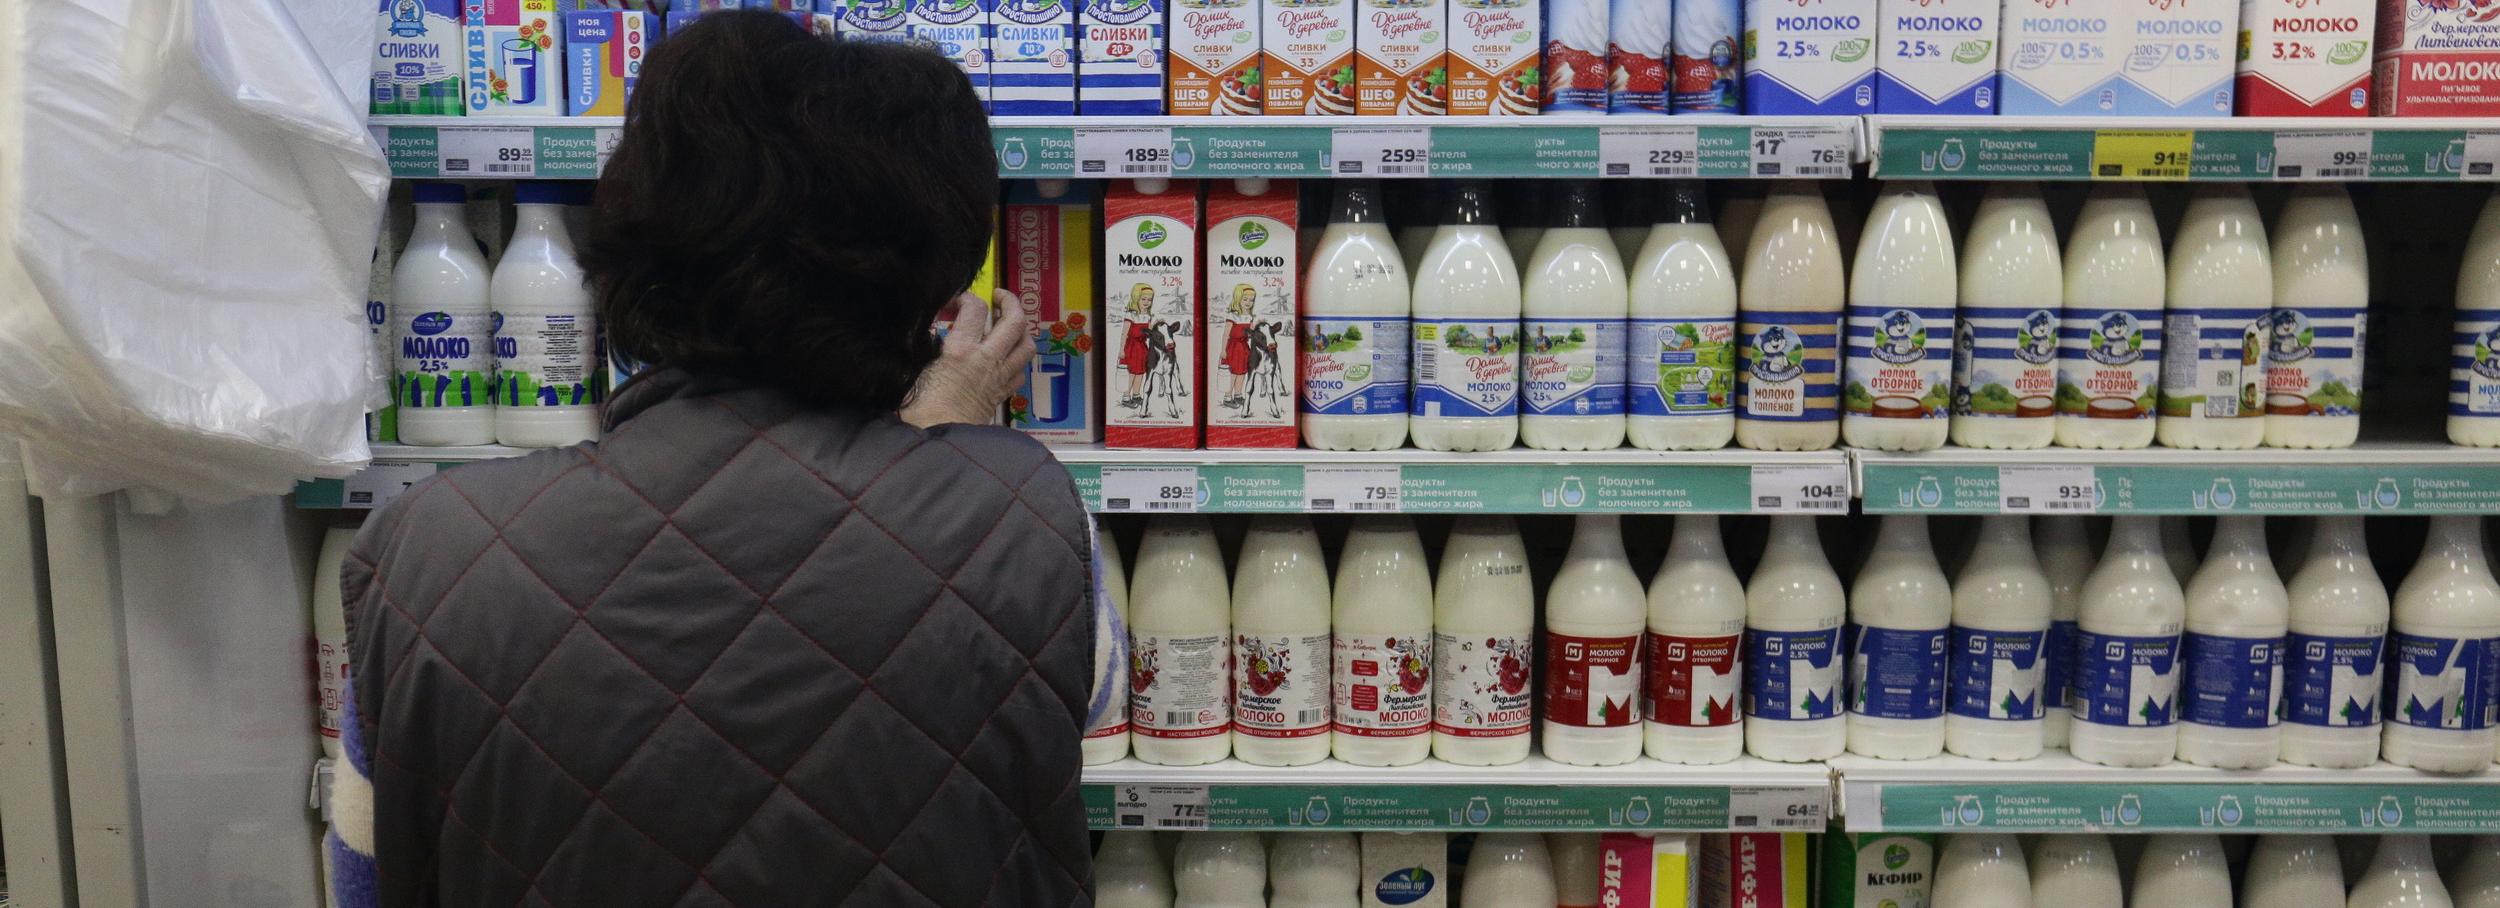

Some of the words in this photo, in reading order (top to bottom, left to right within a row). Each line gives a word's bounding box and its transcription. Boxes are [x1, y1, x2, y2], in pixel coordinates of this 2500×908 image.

[525, 2, 542, 11] 450
[846, 12, 906, 30] ПРОСТОКВАШИНО
[917, 5, 976, 25] ПРОСТОКВАШИНО
[1000, 5, 1061, 25] ПРОСТОКВАШИНО
[1088, 5, 1149, 25] ПРОСТОКВАШИНО
[1184, 11, 1230, 28] Домик
[1278, 10, 1324, 27] Домик
[1371, 11, 1418, 28] Домик
[1463, 11, 1510, 28] Домик
[577, 18, 600, 27] моя
[1194, 24, 1201, 37] в
[1202, 18, 1245, 39] деревне
[1288, 23, 1295, 36] в
[1296, 18, 1339, 38] деревне
[1382, 24, 1388, 37] в
[1390, 18, 1432, 39] деревне
[1474, 24, 1480, 37] в
[1482, 18, 1524, 39] деревне
[1776, 16, 1860, 31] МОЛОКО
[1897, 16, 1982, 32] МОЛОКО
[2022, 18, 2106, 33] МОЛОКО
[2136, 20, 2223, 34] МОЛОКО
[2273, 17, 2358, 33] МОЛОКО
[578, 28, 606, 38] цена
[918, 27, 975, 41] СЛИВКИ
[1002, 27, 1059, 41] СЛИВКИ
[1090, 27, 1147, 41] СЛИВКИ
[1287, 44, 1326, 52] СЛИВКИ
[2414, 34, 2500, 50] Литвиновск
[379, 42, 440, 59] СЛИВКИ
[1024, 43, 1042, 54] 10%
[1111, 43, 1130, 54] 20%
[1193, 45, 1232, 53] СЛИВКИ
[1380, 45, 1420, 53] СЛИВКИ
[1472, 45, 1512, 53] СЛИВКИ
[1776, 41, 1820, 59] 2,5%
[1897, 40, 1940, 59] 2,5%
[2060, 42, 2104, 61] 0,5%
[2175, 44, 2220, 62] 0,5%
[2272, 42, 2315, 60] 3,2%
[466, 0, 488, 111] СЛИВК
[399, 65, 421, 75] 10%
[580, 48, 593, 106] Сливки
[1174, 89, 1209, 100] ШЕФ
[1268, 88, 1303, 100] ШЕФ
[1360, 89, 1395, 100] ШЕФ
[1454, 89, 1488, 100] ШЕФ
[2440, 85, 2481, 93] ПИТЬЕВОЕ
[1208, 138, 1266, 149] Продукты
[1979, 139, 2037, 150] Продукты
[499, 148, 521, 161] 89
[1125, 148, 1158, 162] 189
[1208, 149, 1229, 159] без
[1230, 151, 1298, 159] заменителя
[1382, 149, 1415, 162] 259
[1649, 150, 1683, 163] 229
[1811, 150, 1834, 163] 76
[1978, 150, 2000, 160] без
[2002, 152, 2069, 161] заменителя
[2154, 152, 2176, 165] 91
[2333, 151, 2356, 165] 99
[1208, 162, 1272, 170] молочного
[1274, 161, 1304, 172] жира
[1977, 163, 2037, 172] молочного
[2043, 163, 2073, 174] жира
[1161, 276, 1184, 288] 3,2%
[1263, 276, 1285, 289] 3,2%
[403, 336, 470, 359] МОЛОКО
[420, 360, 449, 373] 2,5%
[1466, 356, 1505, 372] Домик
[1879, 368, 1916, 378] МОЛОКО
[2023, 369, 2052, 378] МОЛОКО
[2095, 370, 2132, 379] МОЛОКО
[1467, 382, 1511, 391] МОЛОКО
[1525, 381, 1566, 391] МОЛОКО
[1871, 378, 1924, 390] ОТБОРНОЕ
[2015, 378, 2055, 390] ОТБОРНОЕ
[2086, 379, 2138, 390] ОТБОРНОЕ
[1482, 393, 1502, 403] 2,5%
[1754, 387, 1795, 400] МОЛОКО
[1754, 401, 1795, 412] ТОПЛЕНОЕ
[1598, 476, 1655, 488] Продукты
[2249, 477, 2305, 489] Продукты
[1160, 486, 1182, 498] 89
[1364, 487, 1387, 499] 79
[1598, 488, 1619, 498] без
[1620, 489, 1687, 498] заменителя
[1801, 485, 1833, 498] 104
[2059, 486, 2081, 498] 93
[2248, 489, 2268, 498] без
[2269, 490, 2337, 498] заменителя
[1598, 499, 1659, 509] молочного
[1663, 499, 1693, 510] жира
[2250, 500, 2311, 510] молочного
[2315, 500, 2344, 511] жира
[1790, 642, 1827, 650] МОЛОКО
[1993, 642, 2032, 651] МОЛОКО
[2132, 648, 2168, 656] МОЛОКО
[1588, 649, 1626, 657] МОЛОКО
[1692, 649, 1728, 657] МОЛОКО
[2333, 648, 2372, 657] МОЛОКО
[1236, 708, 1285, 723] МОЛОКО
[1379, 709, 1429, 723] МОЛОКО
[1344, 796, 1399, 807] Продукты
[1504, 796, 1560, 807] Продукты
[1995, 795, 2050, 806] Продукты
[1173, 804, 1195, 816] 77
[1344, 807, 1364, 816] без
[1367, 808, 1430, 816] заменителя
[1504, 807, 1524, 816] без
[1787, 804, 1808, 816] 64
[1995, 806, 2016, 815] без
[1343, 818, 1403, 826] молочного
[1406, 817, 1434, 827] жира
[1504, 818, 1563, 826] молочного
[1567, 818, 1595, 828] жира
[1996, 817, 2057, 825] молочного
[2060, 817, 2087, 827] жира
